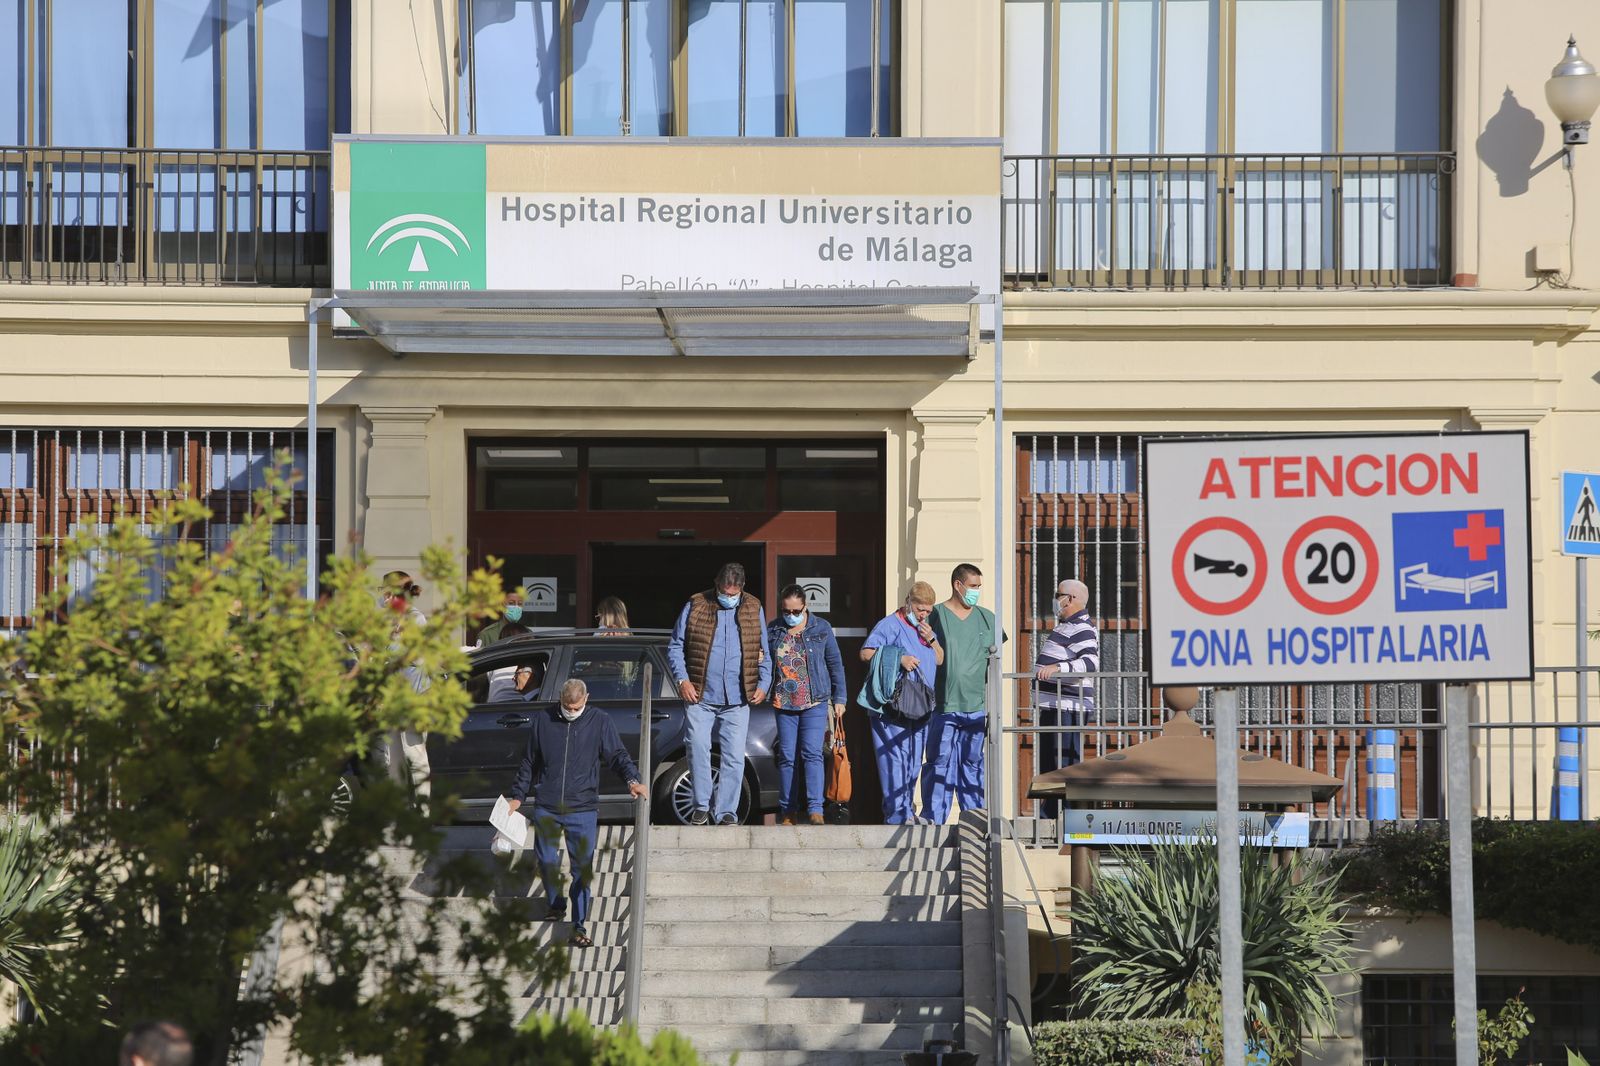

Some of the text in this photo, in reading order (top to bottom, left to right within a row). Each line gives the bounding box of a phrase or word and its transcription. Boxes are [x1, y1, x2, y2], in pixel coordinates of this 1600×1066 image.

[501, 196, 972, 229] Hospital Regional Universitario
[818, 236, 973, 269] de Málaga
[621, 274, 718, 291] Pabellón
[1199, 452, 1478, 499] ATENCION
[1305, 541, 1356, 585] 20
[1170, 623, 1490, 668] ZONA HOSPITALARIA
[1148, 821, 1182, 835] ONCE
